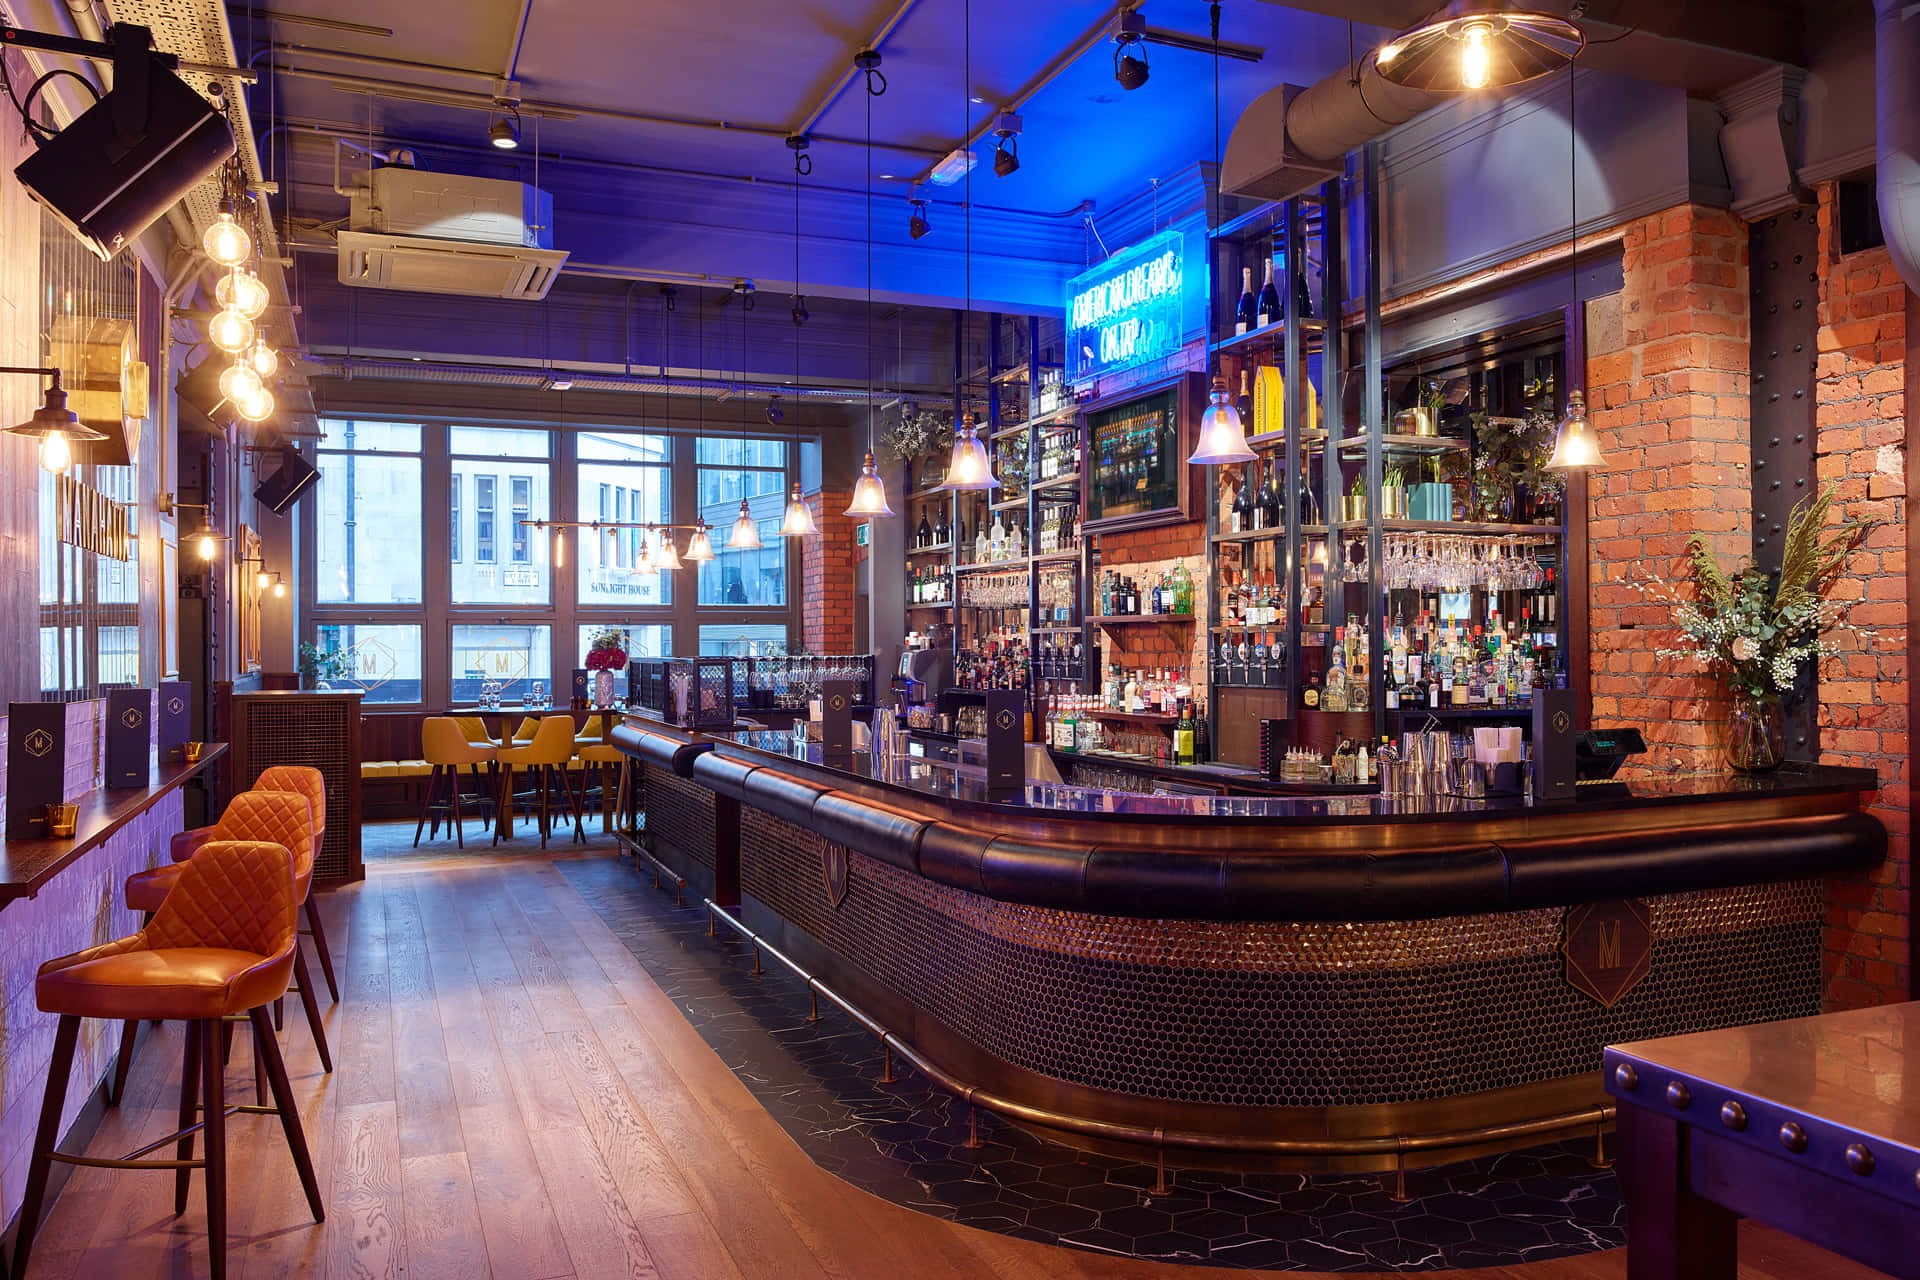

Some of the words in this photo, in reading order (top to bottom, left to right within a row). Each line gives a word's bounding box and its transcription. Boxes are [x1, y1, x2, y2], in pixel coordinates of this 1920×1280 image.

[628, 583, 651, 595] HOUSE
[362, 653, 376, 674] M
[496, 653, 509, 673] M
[1599, 919, 1621, 969] M
